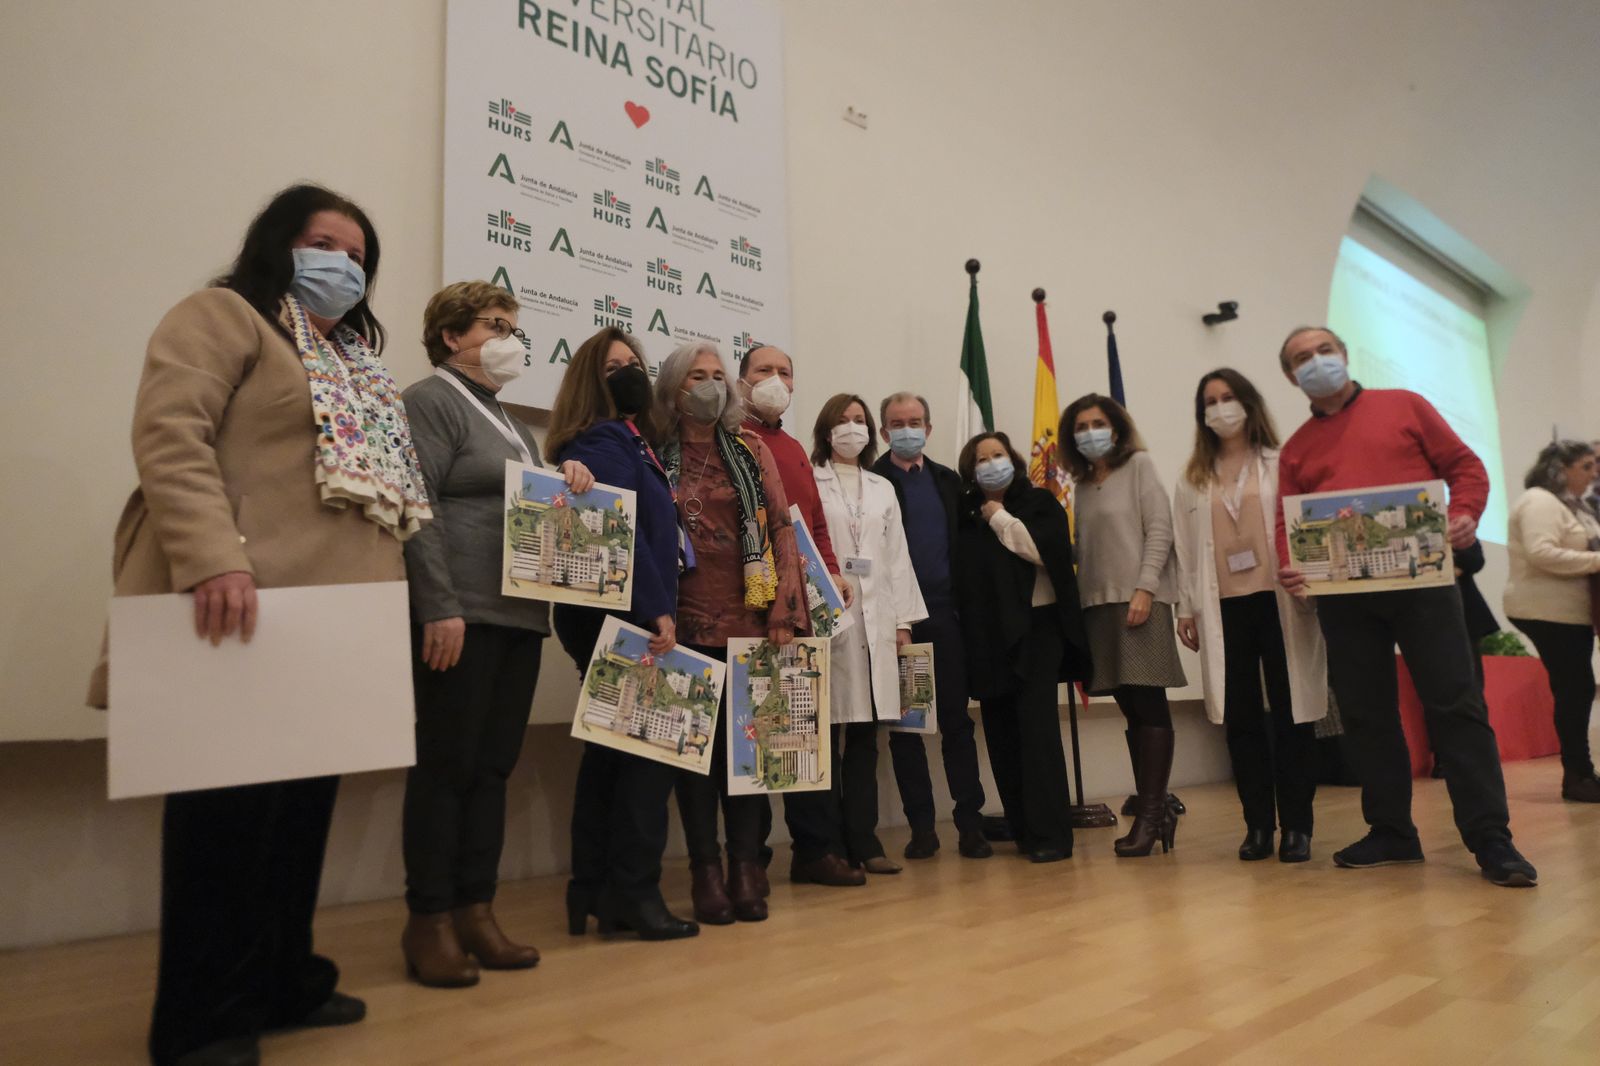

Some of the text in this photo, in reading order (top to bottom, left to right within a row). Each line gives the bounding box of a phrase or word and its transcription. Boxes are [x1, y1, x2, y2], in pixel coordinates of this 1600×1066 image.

[518, 0, 738, 123] REINA SOFÍA
[488, 116, 531, 142] HURS
[645, 174, 680, 196] HURS
[593, 207, 631, 229] HURS
[487, 229, 531, 253] HURS
[579, 247, 595, 257] Junta
[730, 252, 762, 272] HURS
[520, 286, 538, 296] Junta
[647, 275, 682, 296] HURS
